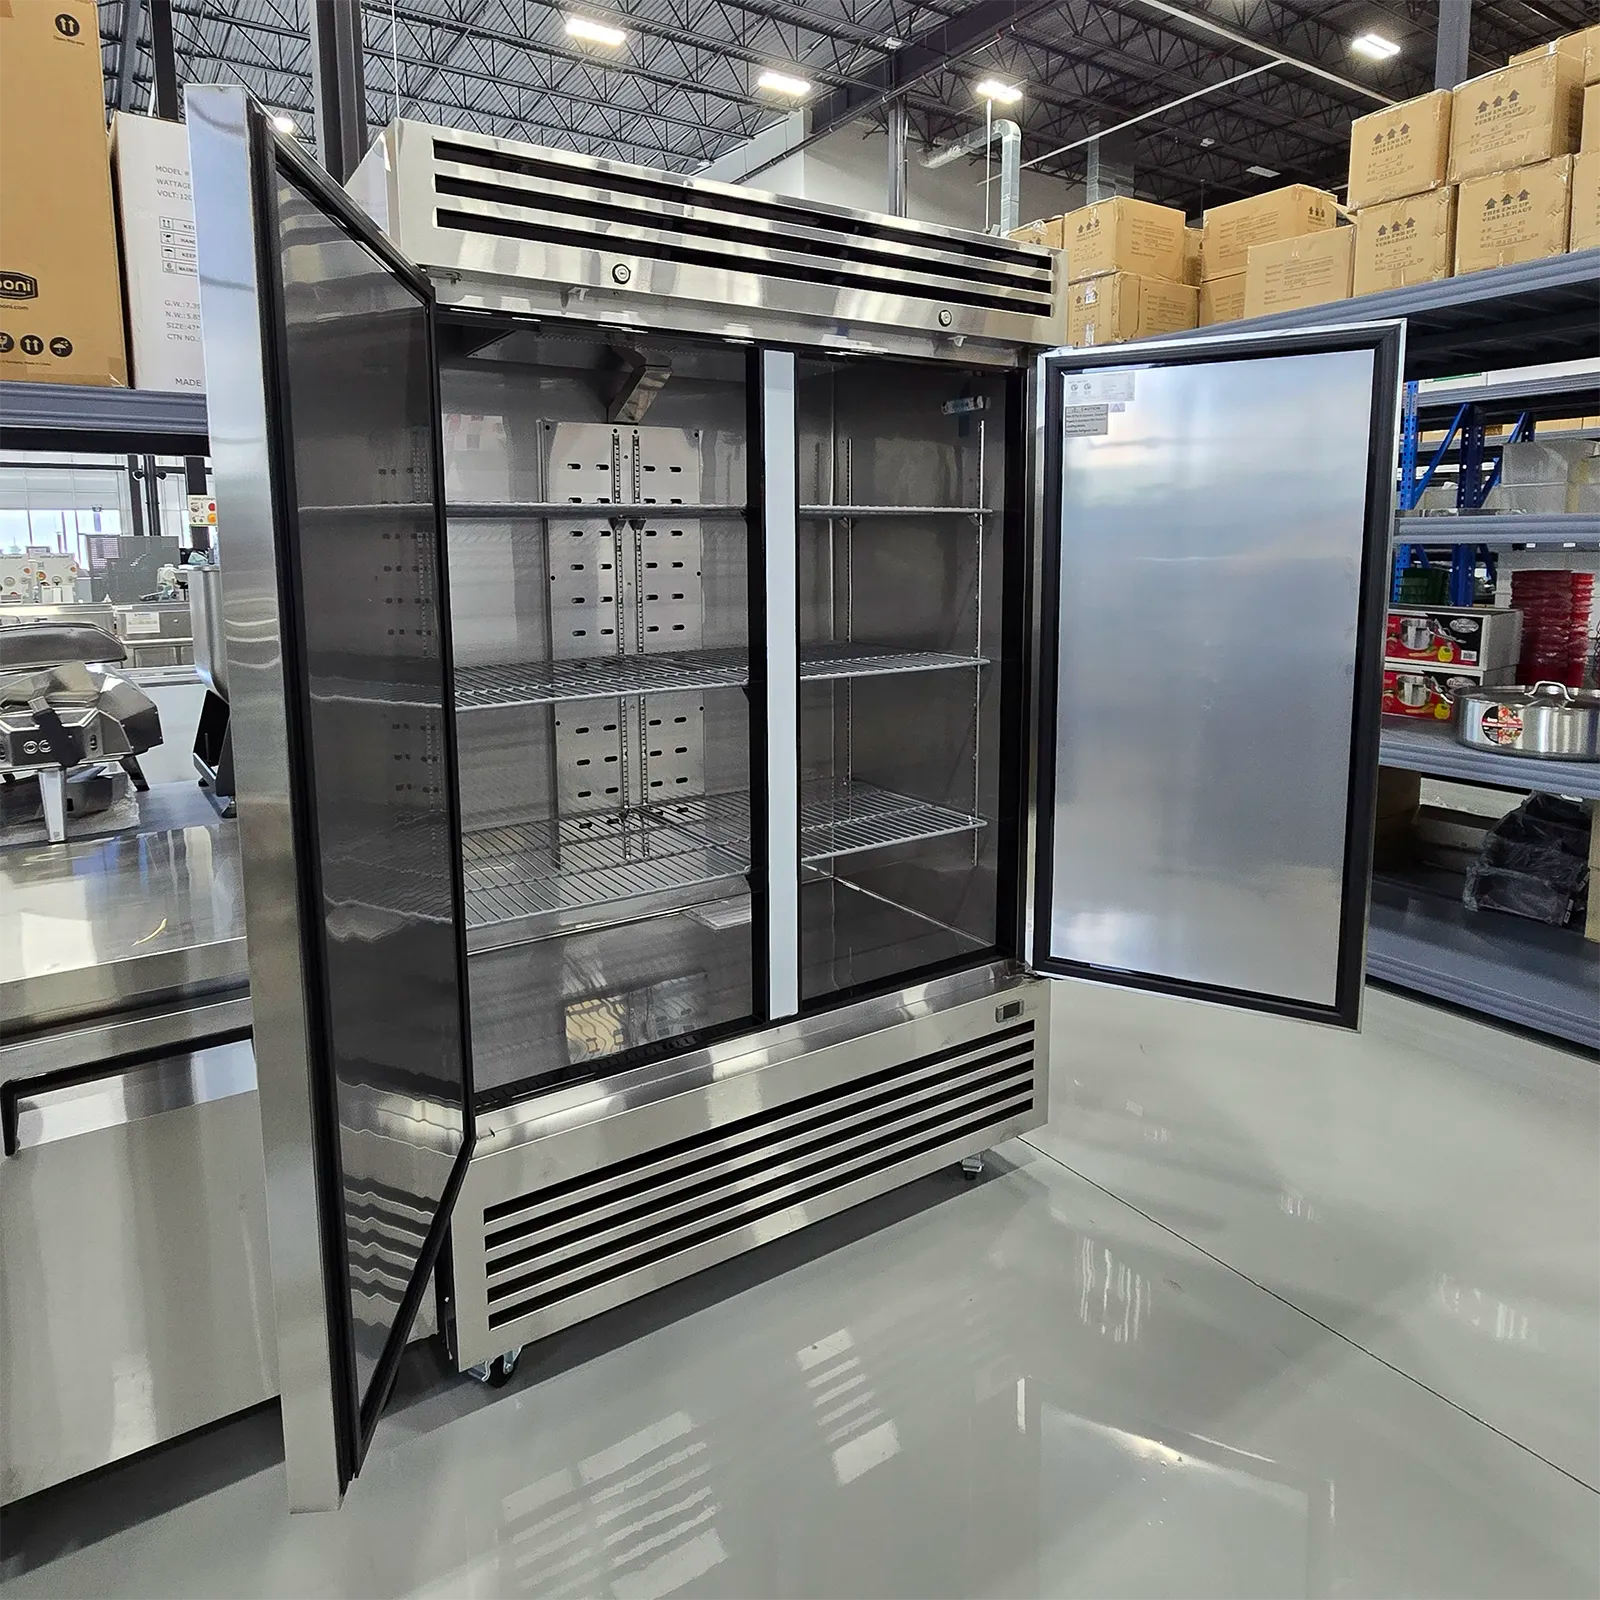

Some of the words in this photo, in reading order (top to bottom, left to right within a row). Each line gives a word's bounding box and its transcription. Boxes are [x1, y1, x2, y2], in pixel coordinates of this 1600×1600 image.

[156, 165, 181, 175] MODEL
[156, 178, 191, 190] WATTAGE
[0, 279, 31, 292] oni
[175, 378, 202, 387] MADE
